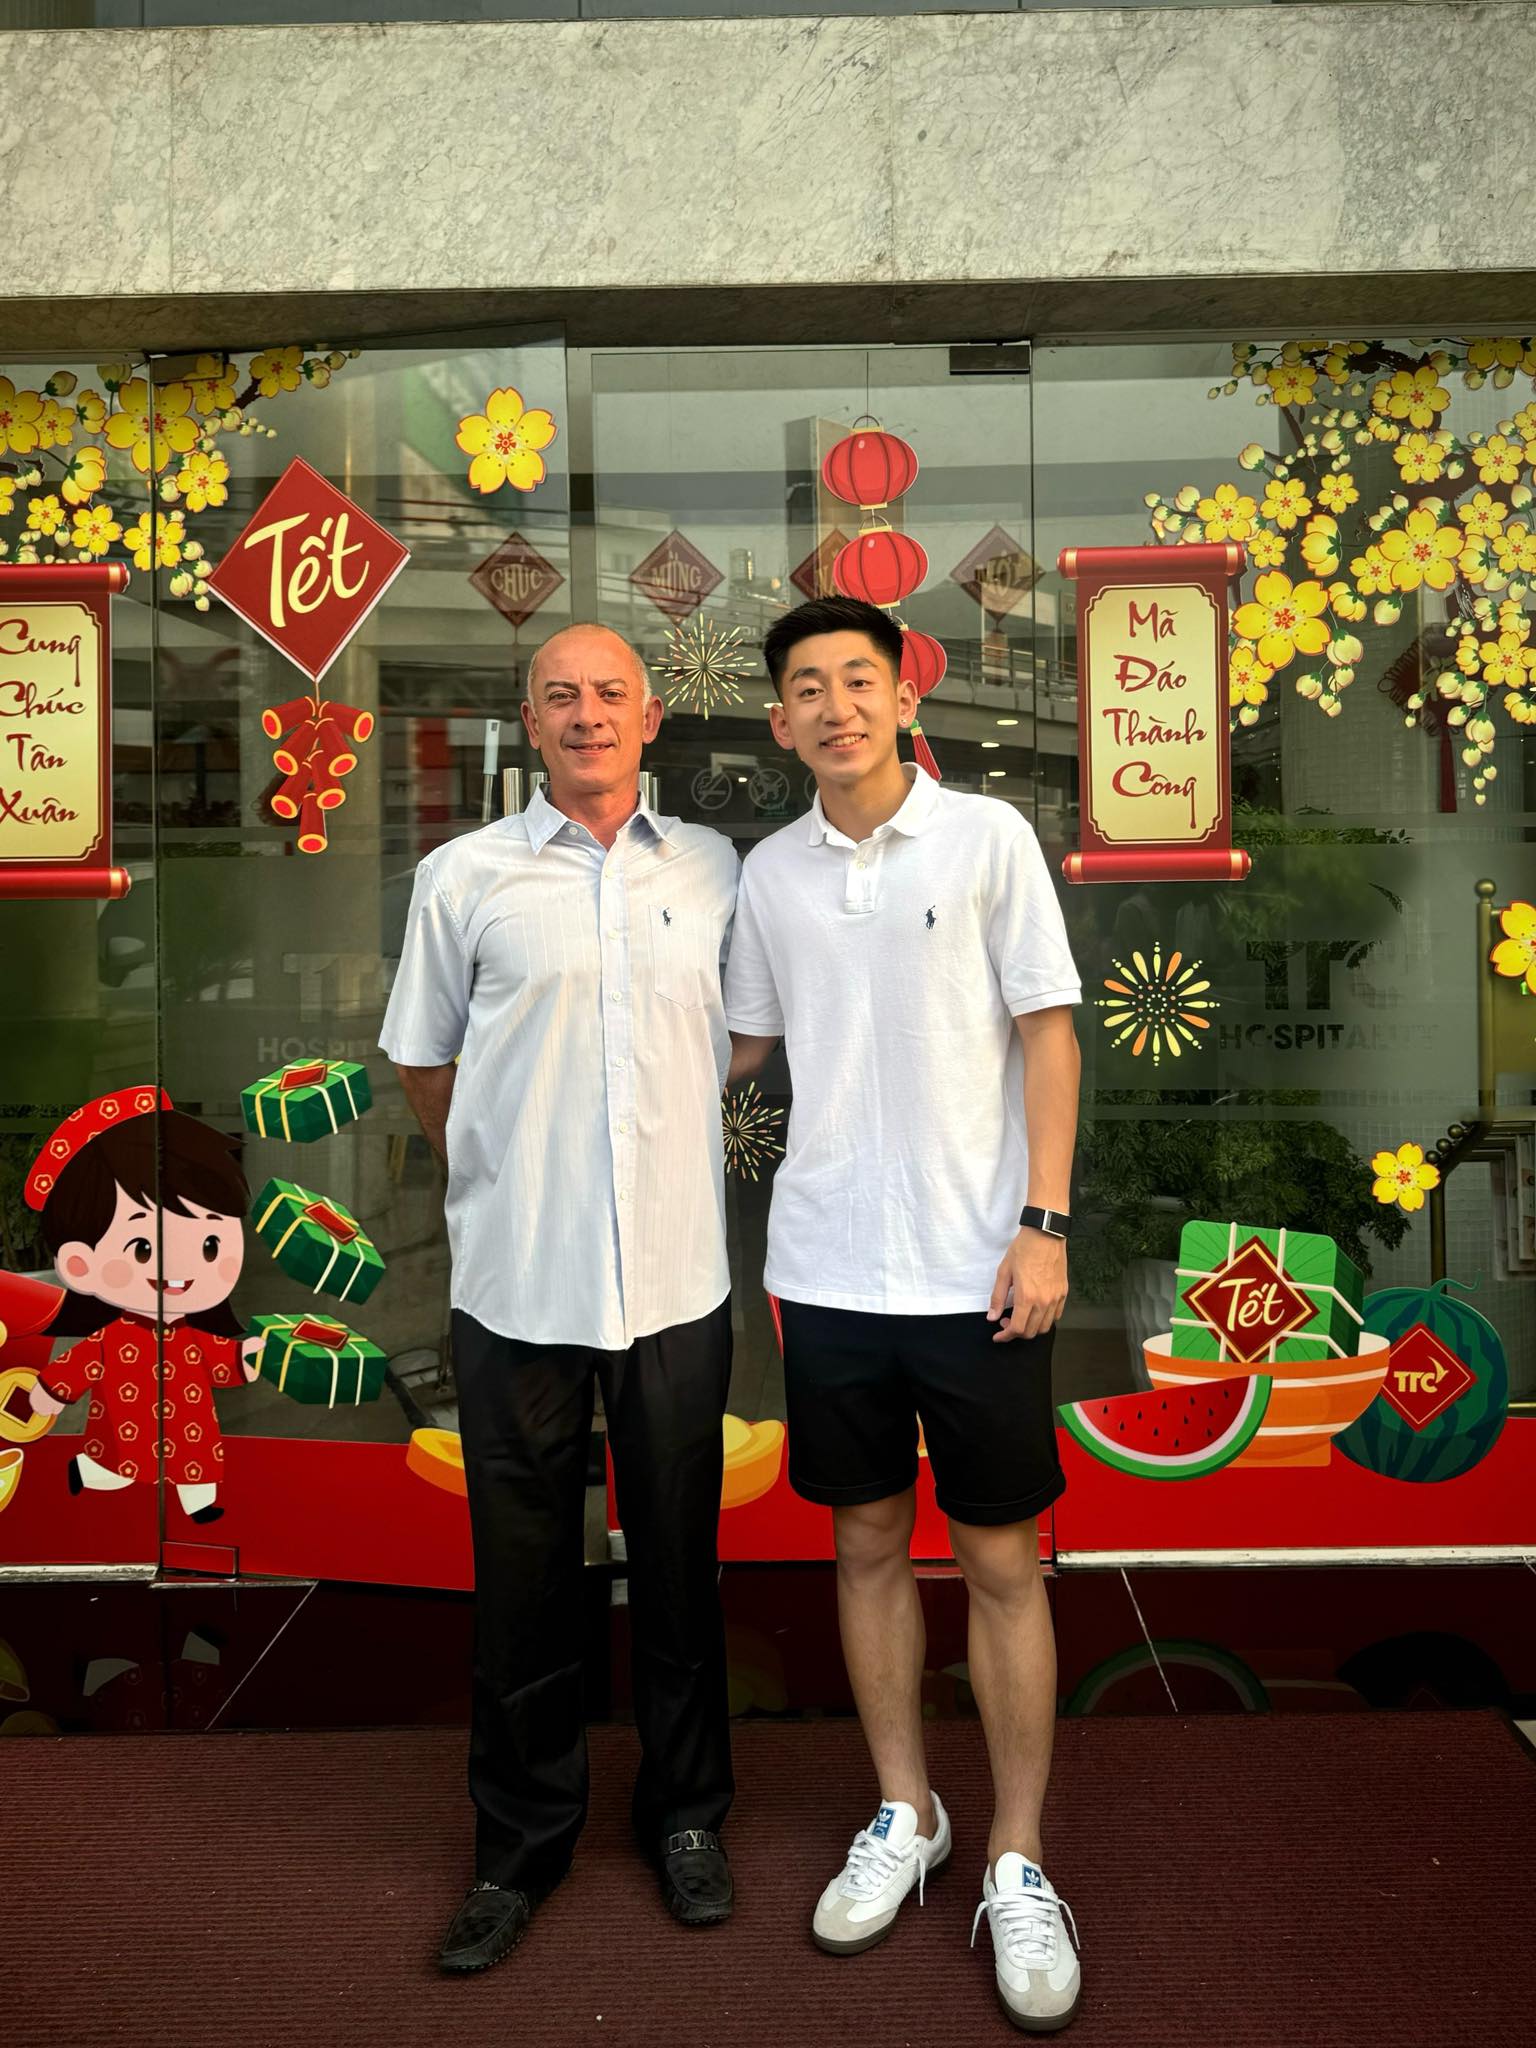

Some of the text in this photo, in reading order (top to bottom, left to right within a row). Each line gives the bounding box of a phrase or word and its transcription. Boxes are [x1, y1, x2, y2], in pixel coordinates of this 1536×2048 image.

[244, 511, 370, 628] Tết
[491, 555, 544, 602] CHÚC
[1128, 600, 1180, 643] Mã
[0, 618, 82, 688] Cung
[1113, 654, 1188, 693] Đáo
[0, 680, 87, 719] Chúc
[1102, 708, 1208, 747] Thành
[6, 733, 68, 772] Tân
[0, 786, 80, 825] Xuân
[1112, 761, 1198, 830] Công
[1217, 1277, 1286, 1332] Tết
[1393, 1371, 1438, 1393] TTC
